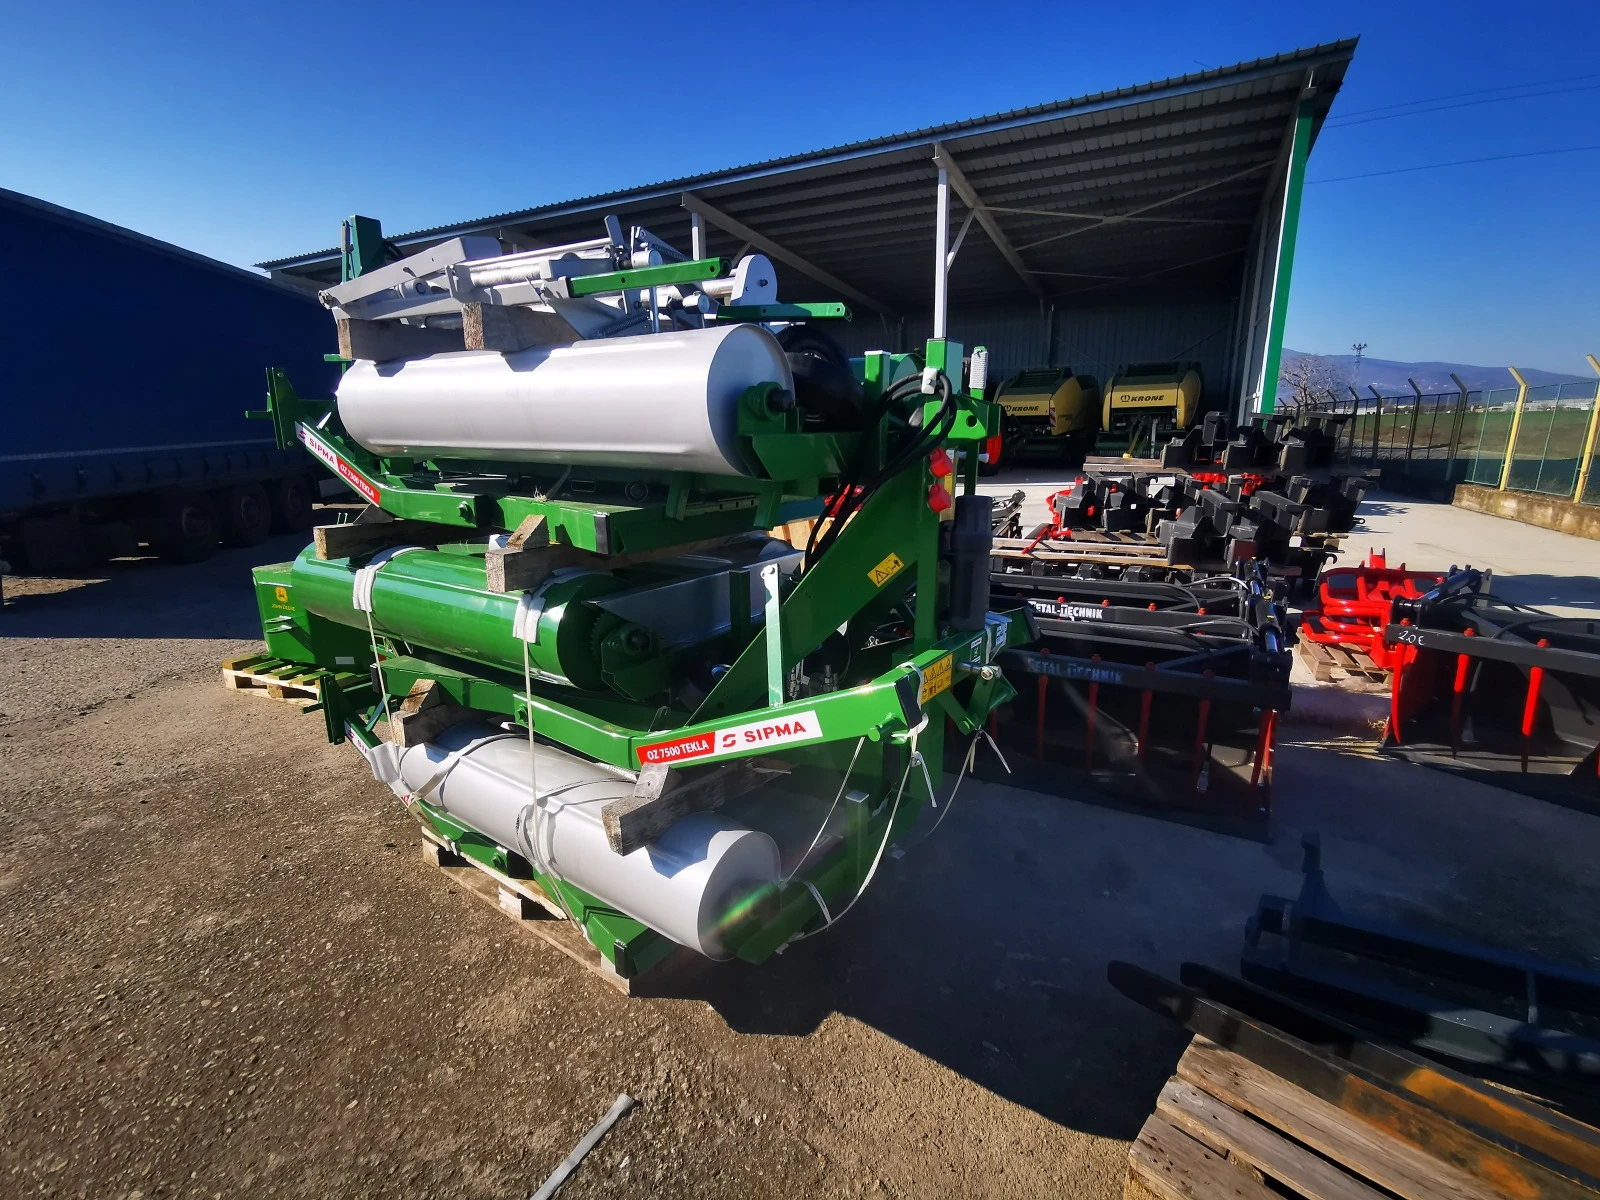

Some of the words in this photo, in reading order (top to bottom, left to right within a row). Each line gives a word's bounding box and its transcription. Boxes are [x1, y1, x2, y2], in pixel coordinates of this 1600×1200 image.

[309, 438, 335, 464] SIPMA
[359, 480, 375, 499] TEKLA
[744, 721, 807, 743] SIPMA
[647, 750, 659, 760] OZ
[661, 745, 681, 758] 7500
[681, 739, 709, 754] TEKLA
